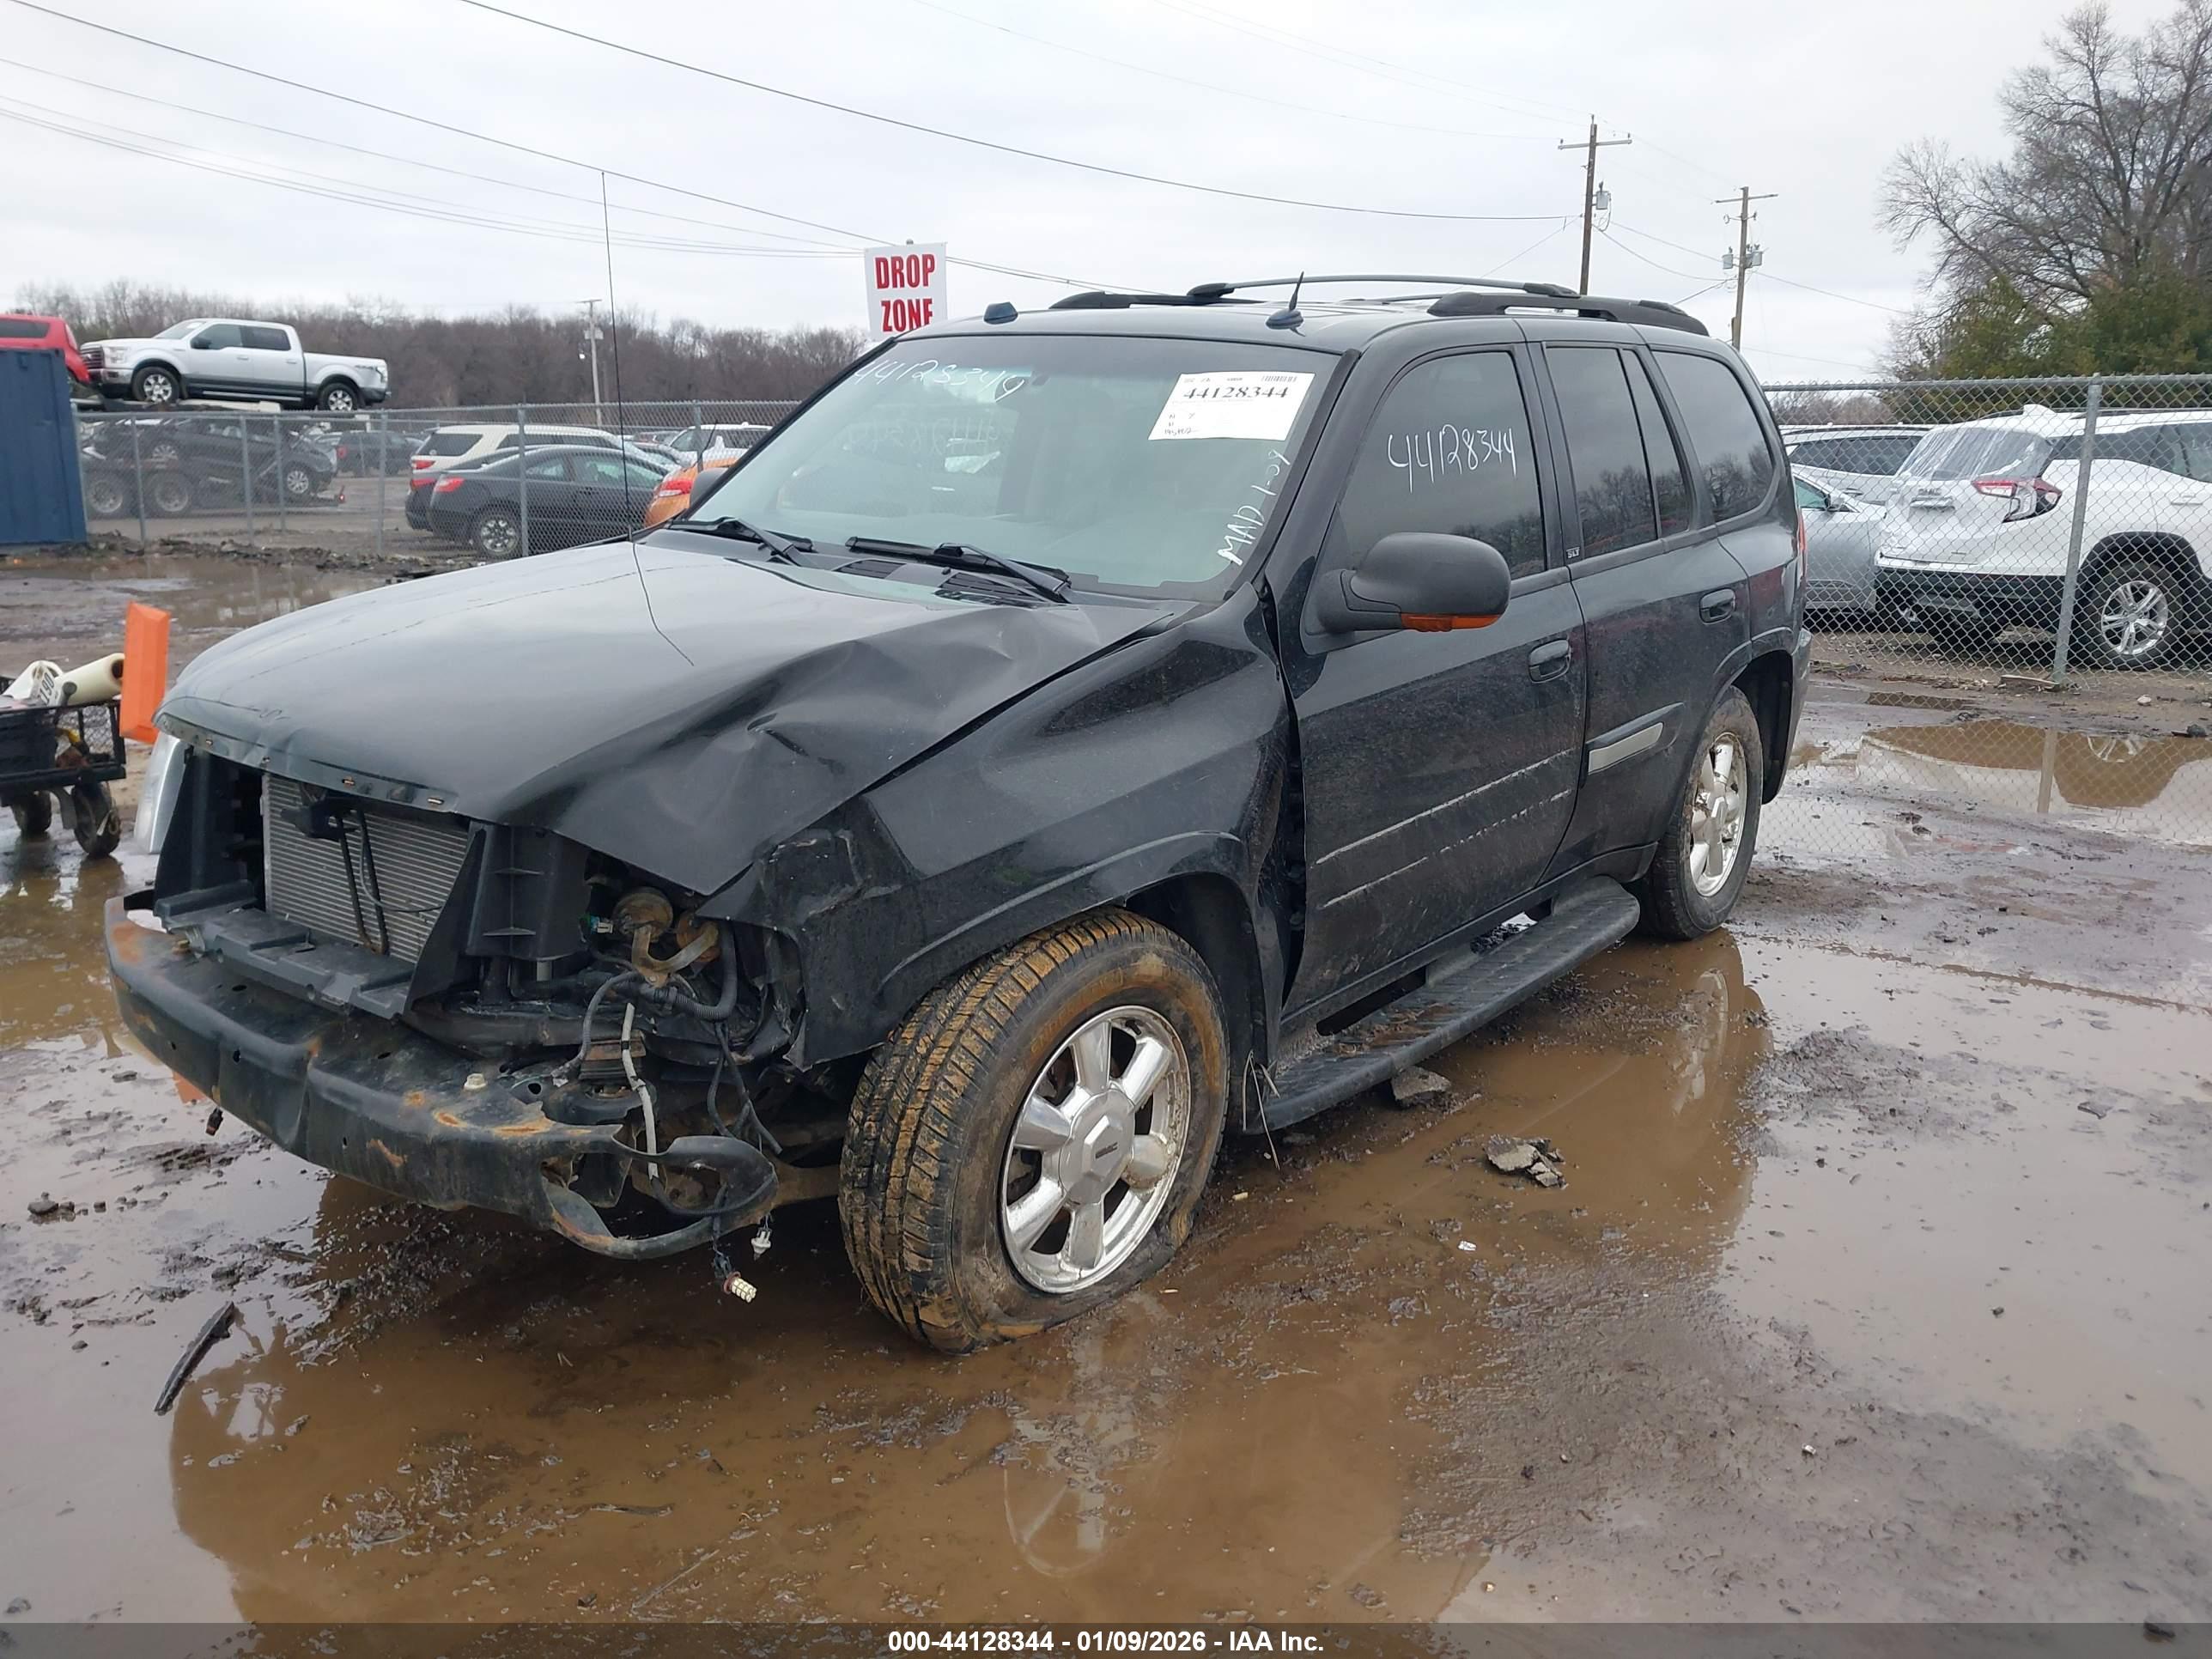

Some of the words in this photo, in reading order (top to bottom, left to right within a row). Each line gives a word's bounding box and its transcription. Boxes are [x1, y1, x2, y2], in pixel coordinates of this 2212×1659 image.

[874, 253, 935, 289] DROP
[880, 297, 933, 332] ZONE
[1183, 386, 1289, 399] 44128344
[1388, 424, 1517, 493] 44128344
[1565, 546, 1581, 559] SLT
